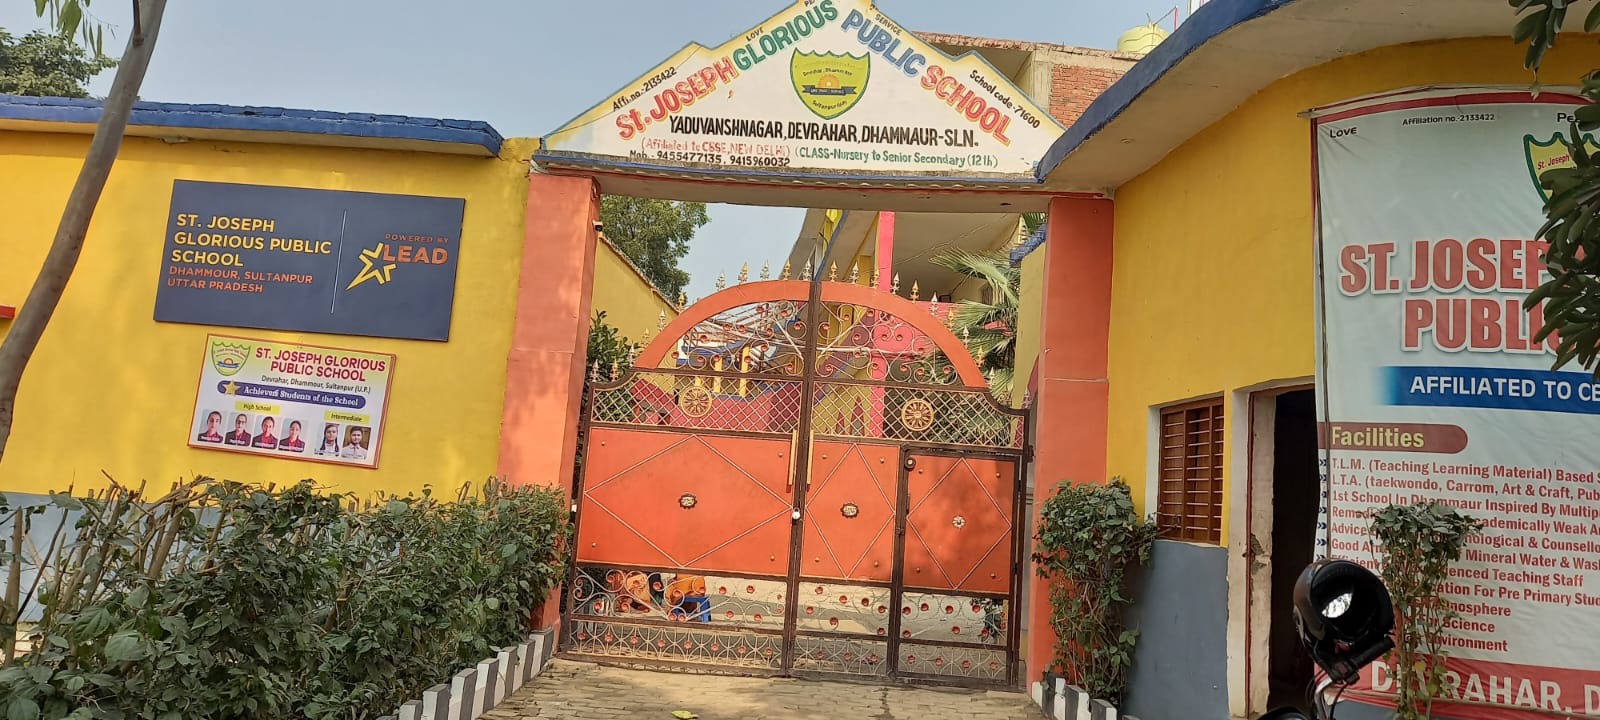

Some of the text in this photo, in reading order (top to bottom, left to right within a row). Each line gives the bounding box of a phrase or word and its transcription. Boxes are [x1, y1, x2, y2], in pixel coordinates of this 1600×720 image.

[746, 27, 764, 42] LOVE
[875, 13, 902, 36] SERVICE
[733, 0, 838, 72] GLORIOUS
[840, 9, 926, 77] PUBLIC
[921, 65, 1011, 147] SCHOOL
[969, 69, 996, 98] School
[1402, 116, 1443, 126] Affiliation
[1329, 126, 1358, 139] LOVE
[730, 156, 790, 167] 9415960032
[872, 149, 881, 162] to
[883, 151, 912, 164] Senior
[914, 152, 966, 168] Secondary
[1548, 153, 1570, 167] Joseph
[176, 213, 275, 233] ST. JOSEPH
[173, 231, 332, 254] GLORIOUS PUBLIC
[384, 232, 433, 244] POWERED
[171, 249, 244, 267] SCHOOL
[383, 244, 449, 265] LEAD
[169, 265, 313, 284] DHAMMOUR, SULTANPUR
[1340, 242, 1400, 293] ST.
[1410, 238, 1552, 290] JOSEP
[167, 278, 264, 293] UTTAR PRADESH
[255, 347, 272, 360] ST.
[274, 350, 321, 365] JOSEPH
[324, 354, 386, 372] GLORIOUS
[270, 361, 366, 382] PUBLIC SCHOOL
[280, 390, 312, 401] Students
[312, 394, 321, 402] of
[321, 396, 334, 404] the
[334, 397, 359, 407] School
[325, 383, 354, 393] Sultanpur
[1409, 375, 1536, 398] AFFILIATED
[1542, 380, 1573, 402] TO
[1331, 426, 1425, 448] Facilities
[1332, 457, 1366, 471] T.L.M.
[1368, 459, 1430, 475] (Teaching
[1432, 462, 1490, 479] Learning
[1492, 464, 1552, 483] Material)
[1556, 469, 1594, 484] Based
[1332, 473, 1362, 487] L.T.A.
[1365, 475, 1442, 492] (taekwondo,
[1446, 479, 1499, 496] Carrom,
[1502, 482, 1522, 496] Art
[1524, 484, 1535, 497] &
[1538, 485, 1574, 501] Craft,
[1333, 490, 1348, 502] 1st
[1351, 491, 1392, 505] School
[1395, 493, 1407, 505] In
[1485, 498, 1538, 515] Inspired
[1541, 502, 1557, 518] By
[1331, 521, 1368, 536] Advice
[1527, 536, 1539, 549] &
[1473, 516, 1550, 535] cademically
[1553, 520, 1588, 535] Weak
[1331, 538, 1360, 551] Good
[1465, 548, 1516, 565] Mineral
[1519, 552, 1557, 568] Water
[1559, 556, 1570, 569] &
[1491, 568, 1551, 587] Teaching
[1552, 573, 1584, 588] Staff
[1474, 584, 1496, 598] For
[1498, 586, 1520, 600] Pre
[1523, 588, 1572, 607] Primary
